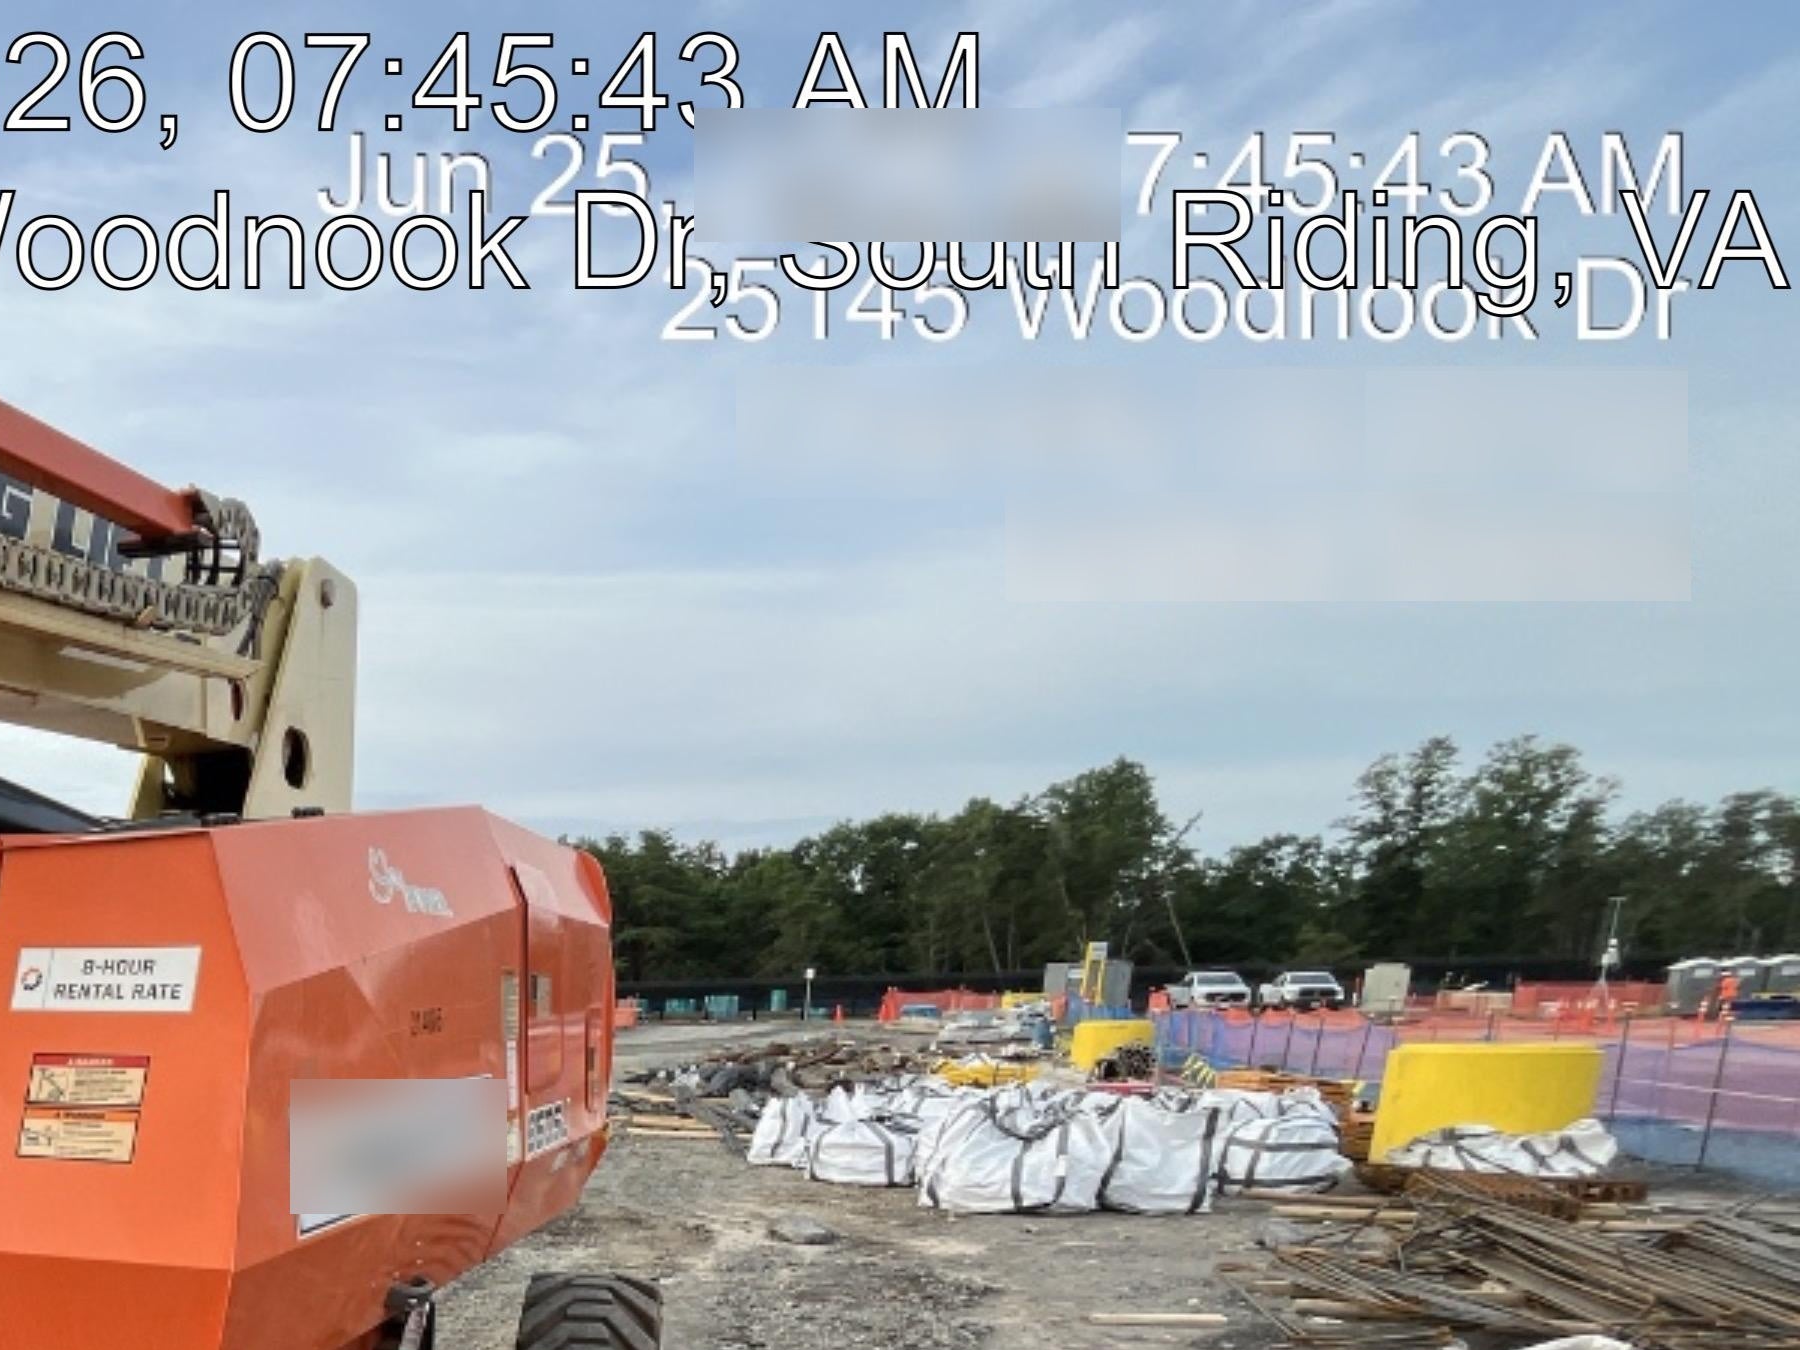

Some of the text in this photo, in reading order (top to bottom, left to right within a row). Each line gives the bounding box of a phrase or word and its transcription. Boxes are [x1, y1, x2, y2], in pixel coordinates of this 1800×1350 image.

[81, 958, 157, 976] 8-HOUR
[53, 983, 184, 1001] RENTAL RATE
